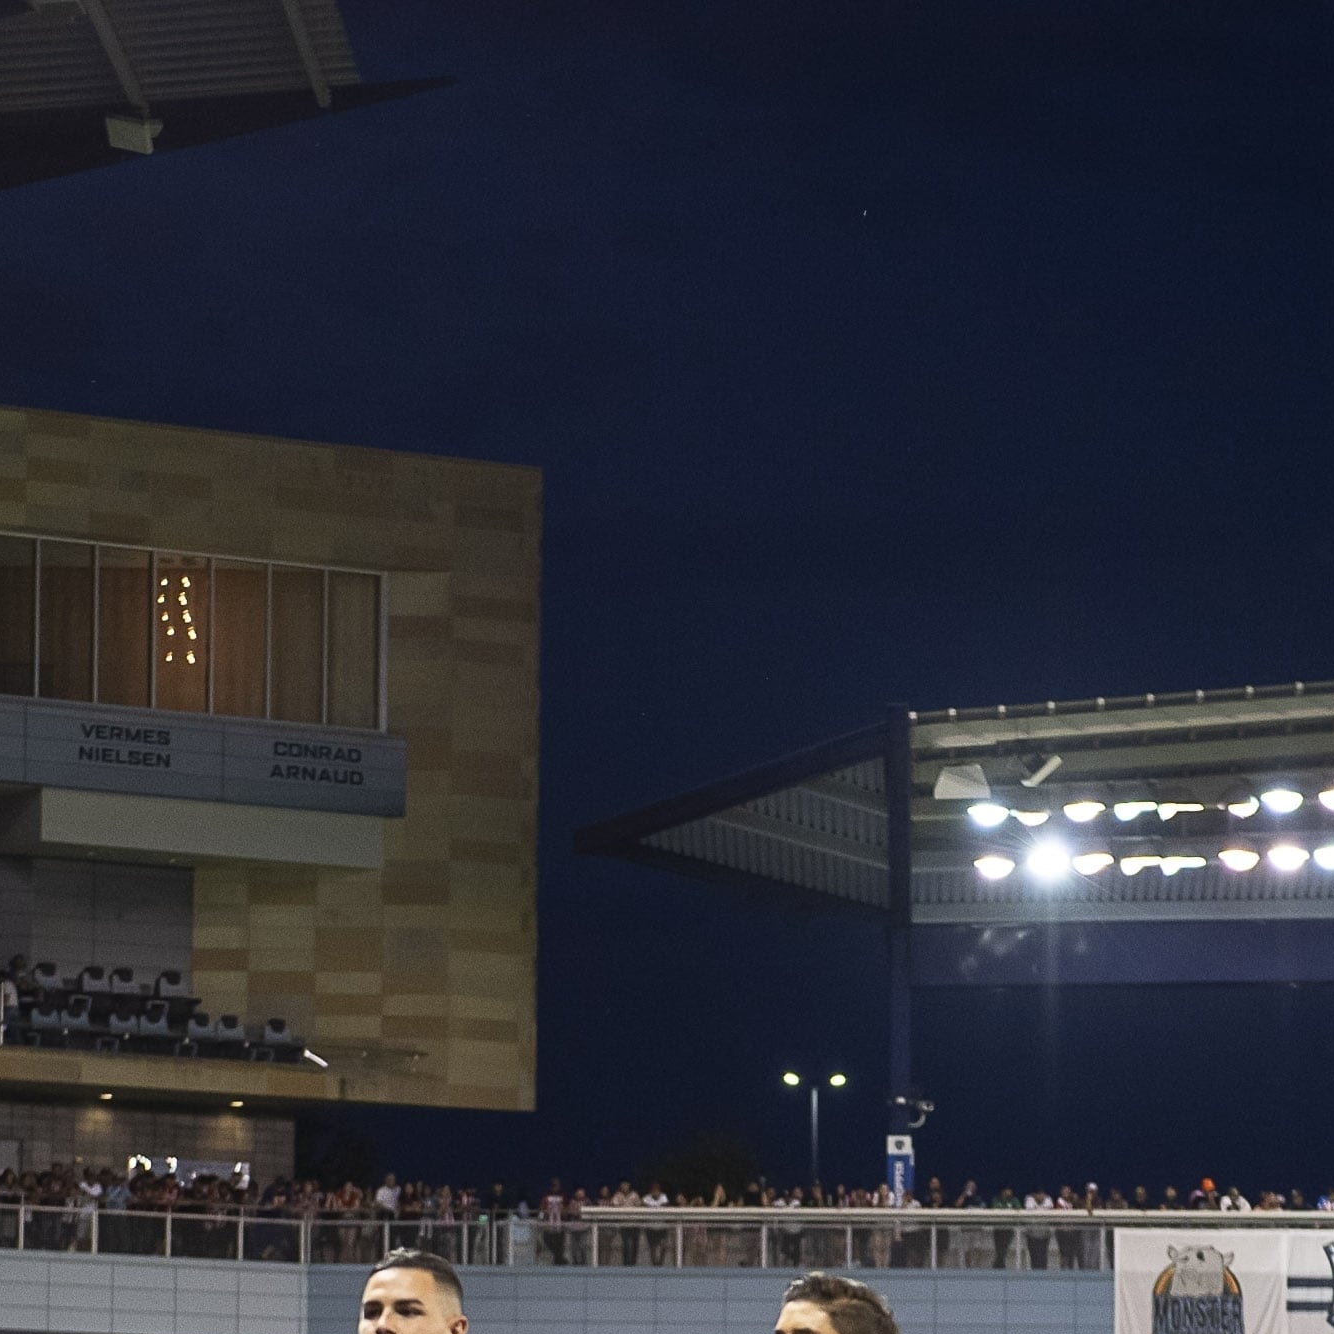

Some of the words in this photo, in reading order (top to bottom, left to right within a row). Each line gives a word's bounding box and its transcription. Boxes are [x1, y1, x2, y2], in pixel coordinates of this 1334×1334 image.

[81, 722, 171, 746] VERMES
[78, 745, 171, 769] NIELSEN
[273, 739, 362, 763] CONRAD
[269, 762, 365, 787] ARNAUD
